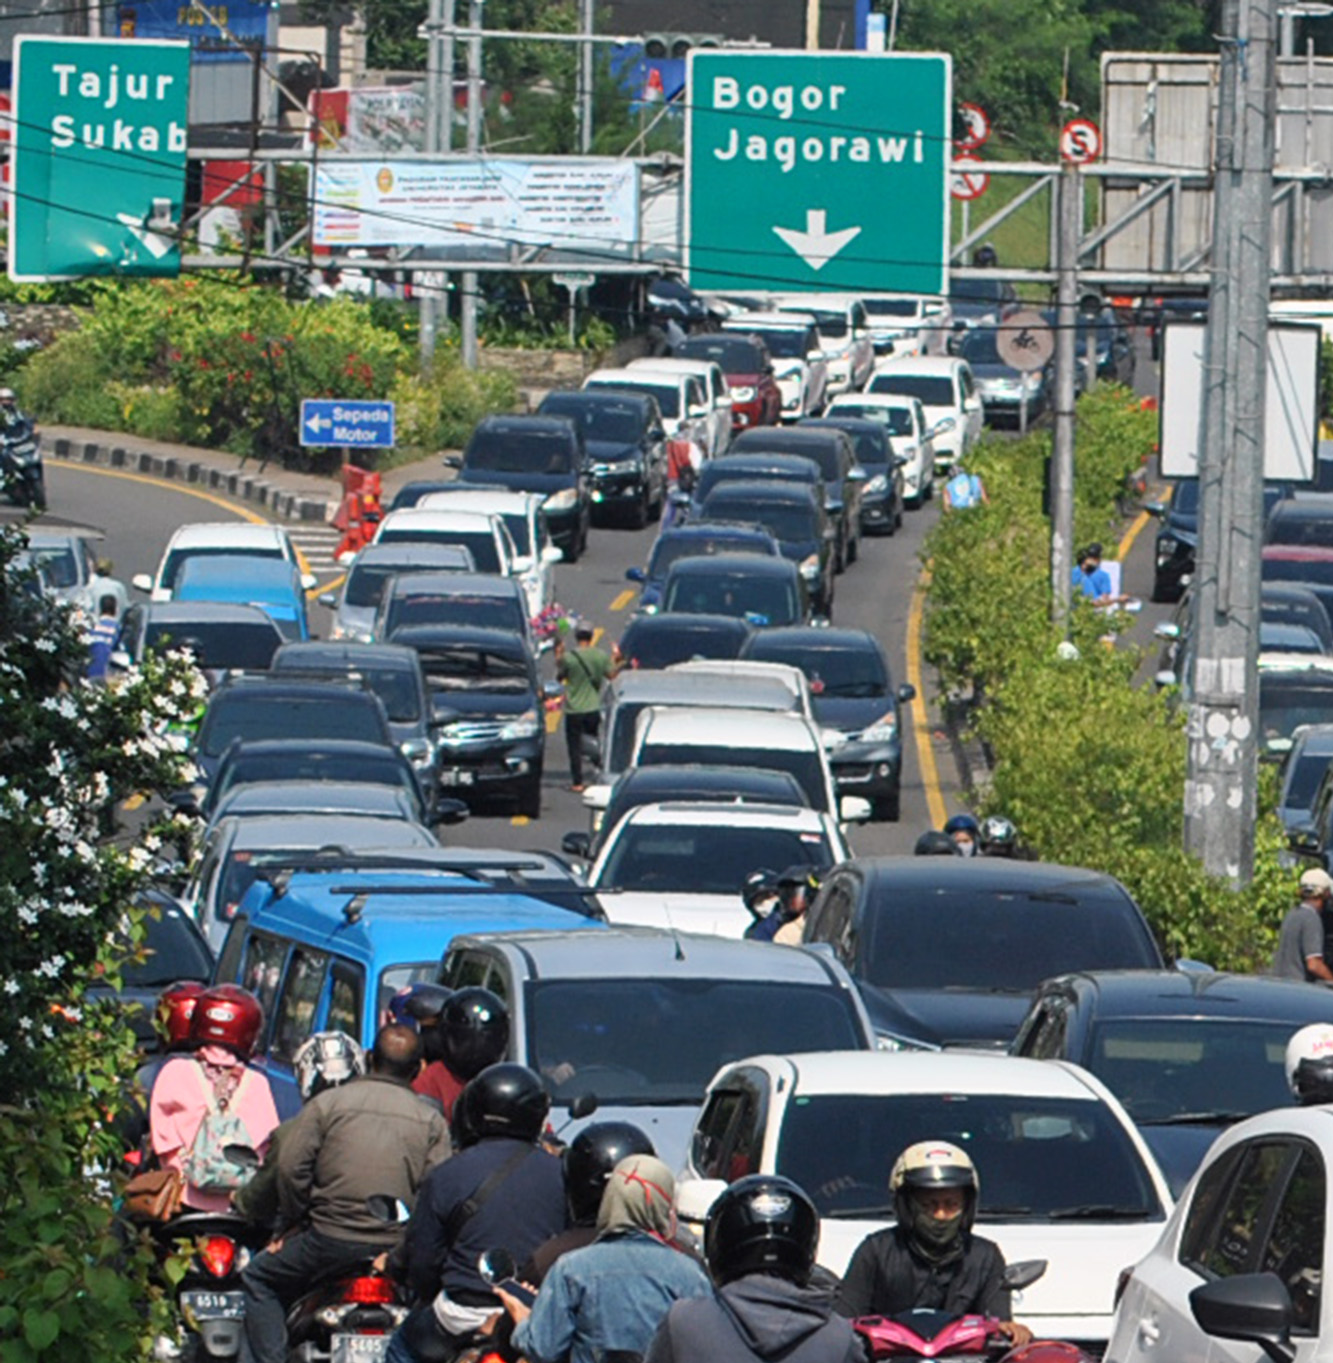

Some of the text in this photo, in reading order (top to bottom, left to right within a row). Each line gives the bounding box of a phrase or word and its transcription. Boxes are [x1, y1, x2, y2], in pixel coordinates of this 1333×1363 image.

[52, 64, 174, 109] Tajur
[713, 76, 847, 120] Bogor
[713, 128, 923, 172] Jagorawi
[332, 406, 388, 424] Sepeda
[333, 427, 378, 441] Motor
